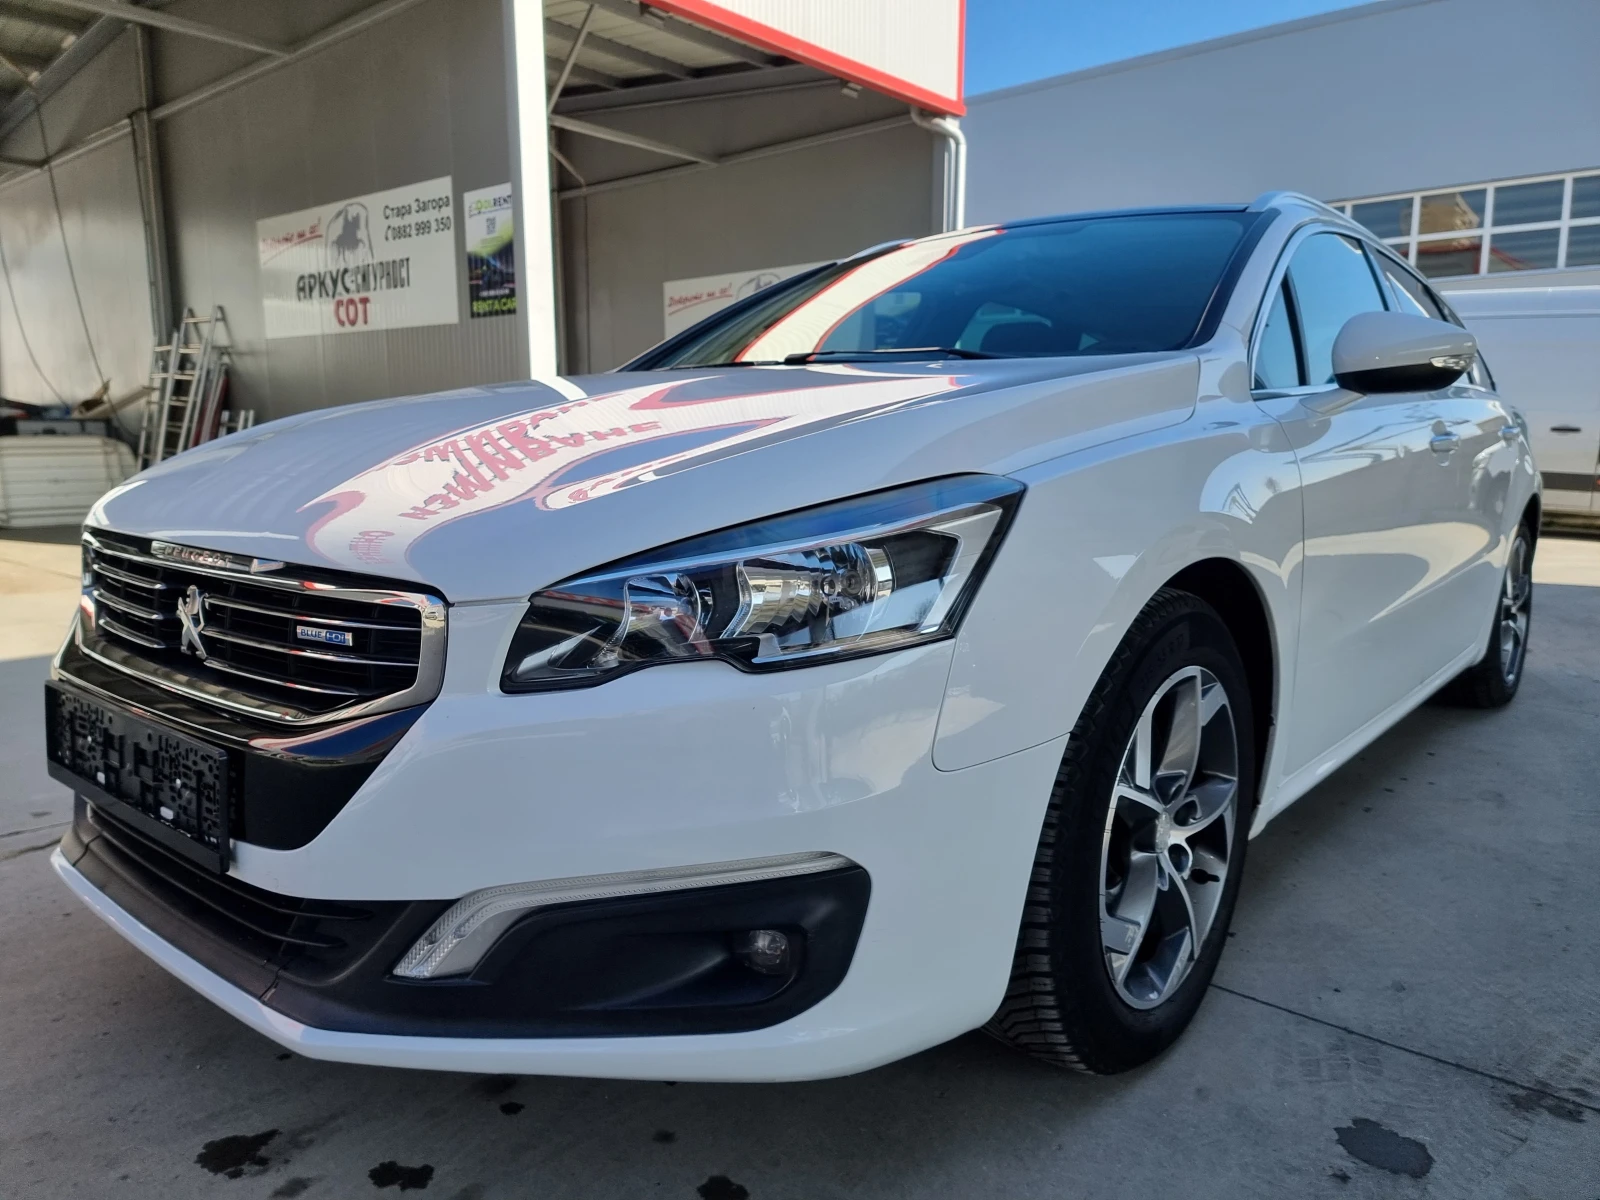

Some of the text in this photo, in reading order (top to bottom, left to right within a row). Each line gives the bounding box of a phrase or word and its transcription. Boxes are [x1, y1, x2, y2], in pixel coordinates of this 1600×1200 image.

[383, 195, 450, 220] Стара Загора
[414, 220, 432, 236] 999
[434, 215, 452, 232] 350
[335, 296, 370, 327] СОТ
[164, 545, 233, 568] PEUGEOT
[300, 629, 323, 639] BLUE
